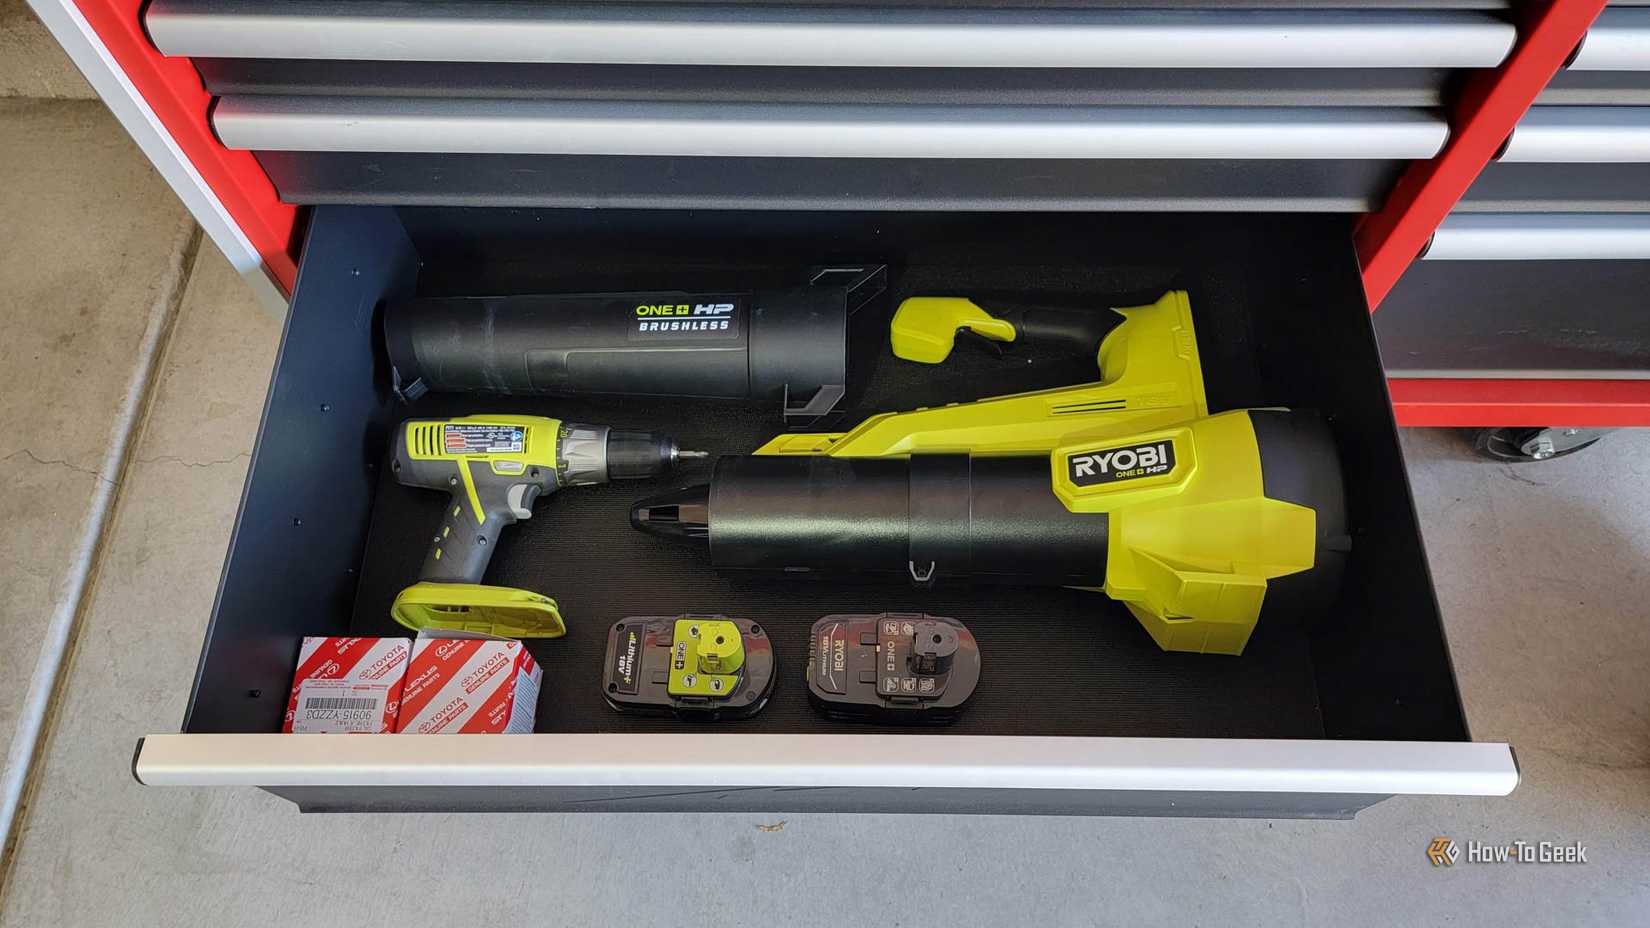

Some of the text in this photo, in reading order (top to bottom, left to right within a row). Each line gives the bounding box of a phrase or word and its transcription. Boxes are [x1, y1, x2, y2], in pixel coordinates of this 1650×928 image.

[693, 304, 734, 314] HP
[639, 321, 729, 331] BRUSHLESS
[1072, 444, 1168, 477] RYOBI
[371, 644, 404, 671] TOYOTA
[472, 652, 505, 678] TOYOTA
[618, 654, 626, 674] 18V
[834, 639, 845, 671] RYOBI
[430, 697, 463, 723] TOYOTA
